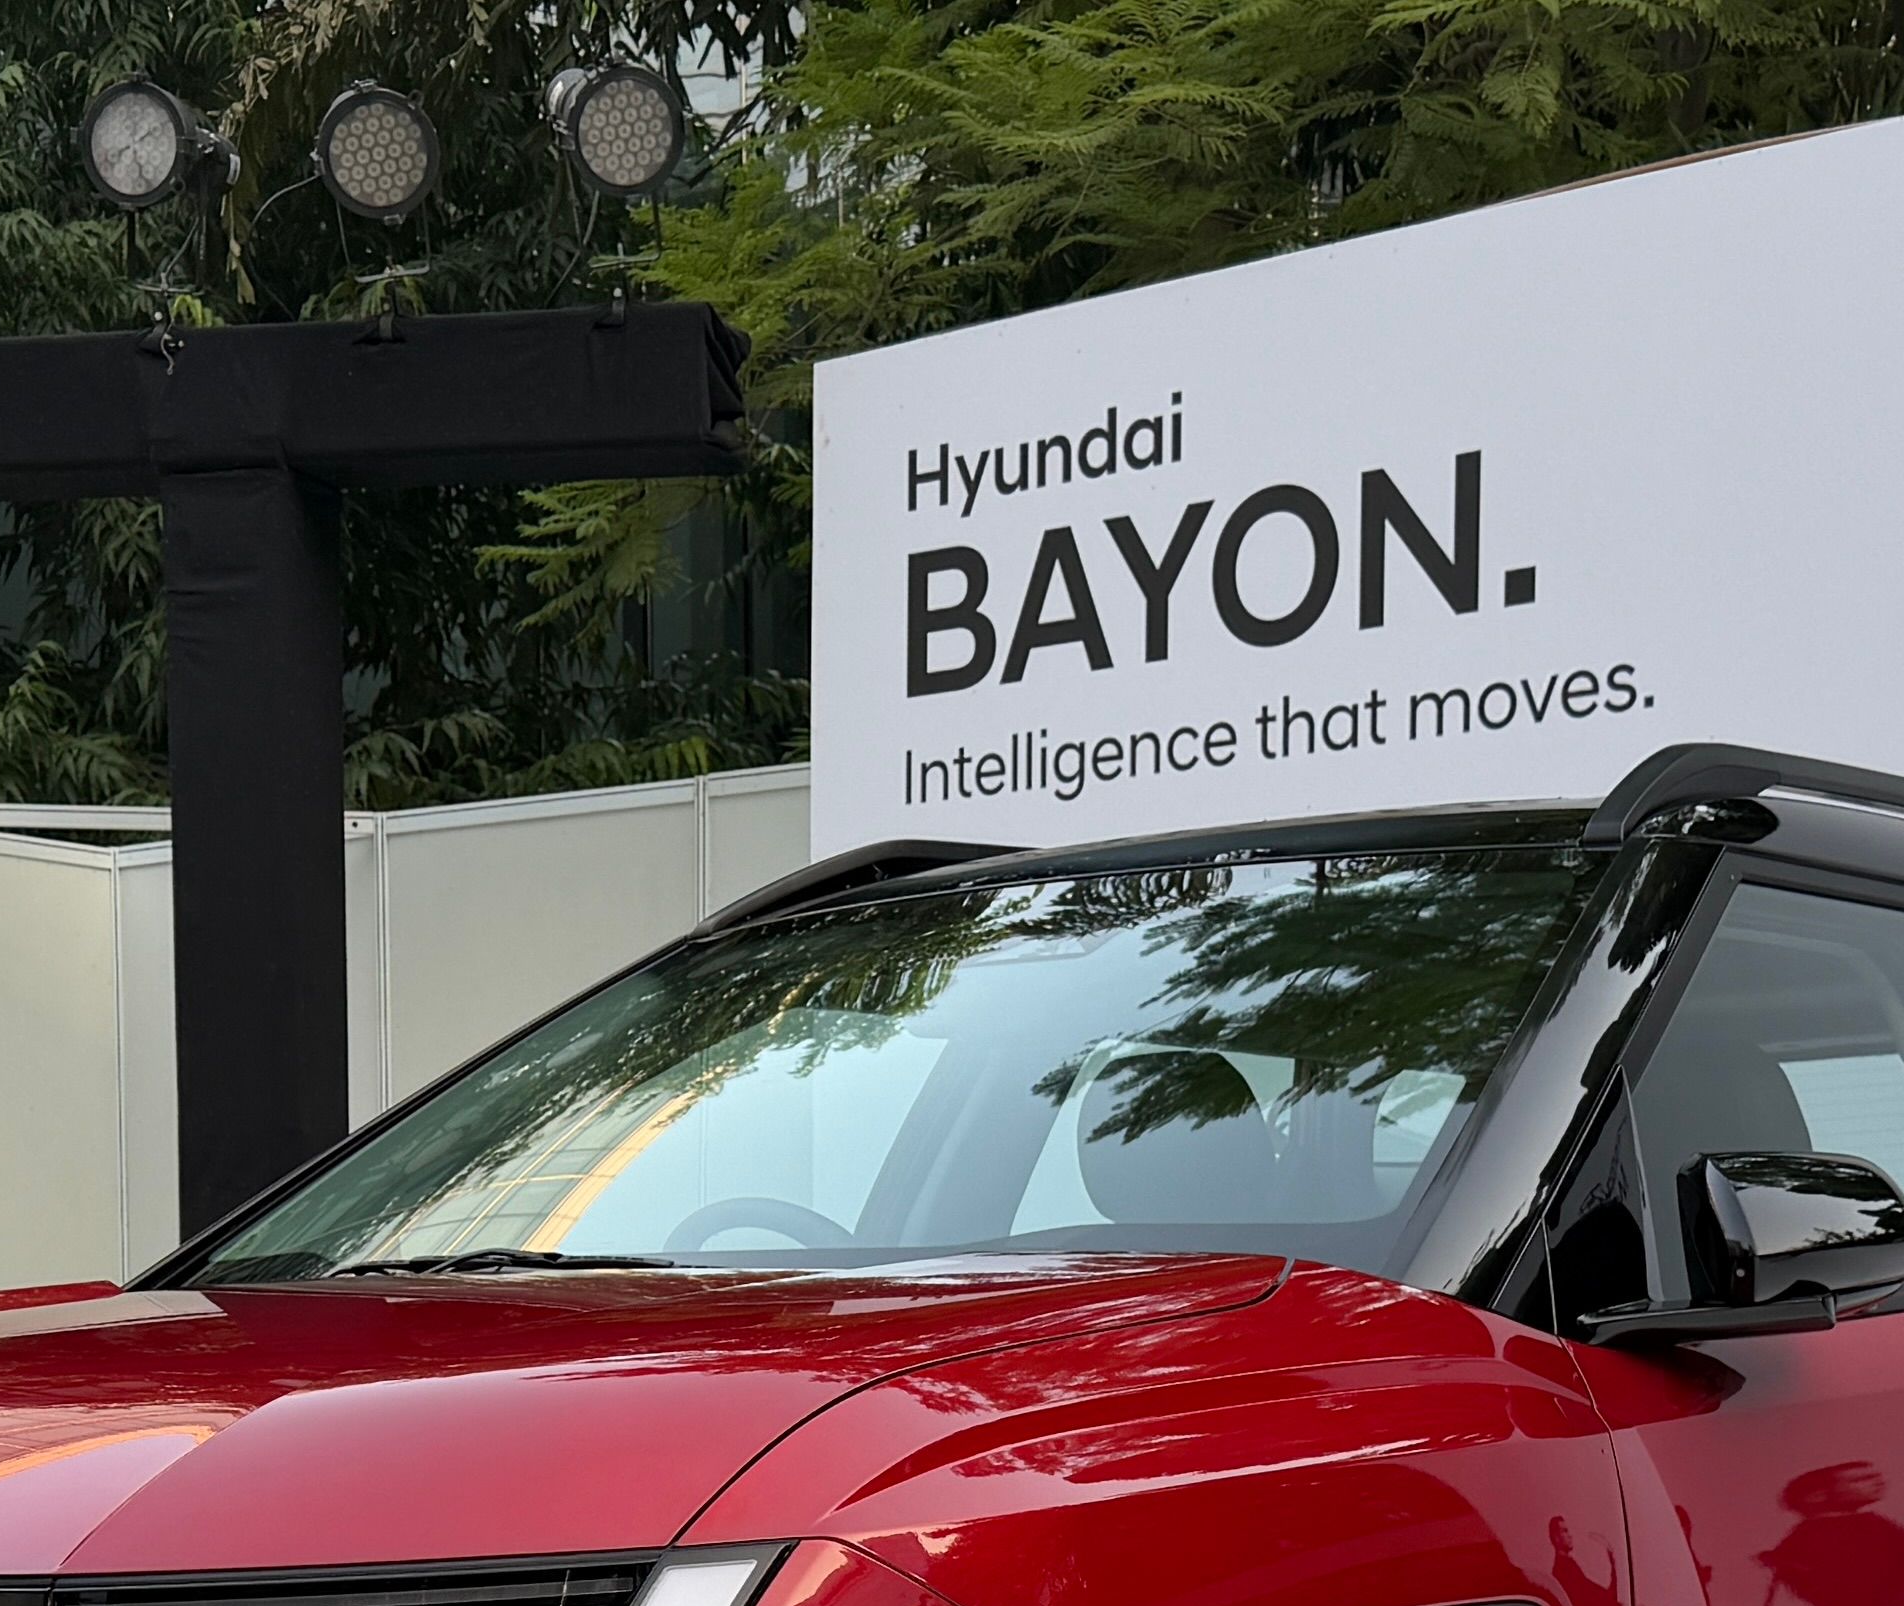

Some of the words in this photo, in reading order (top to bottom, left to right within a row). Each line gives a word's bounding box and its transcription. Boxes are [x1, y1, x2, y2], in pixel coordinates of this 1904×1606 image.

[906, 391, 1183, 518] Hyundai
[906, 450, 1537, 699] BAYON.
[905, 721, 1237, 805] Intelligence
[1255, 689, 1387, 760] that
[1409, 663, 1655, 741] moves.
